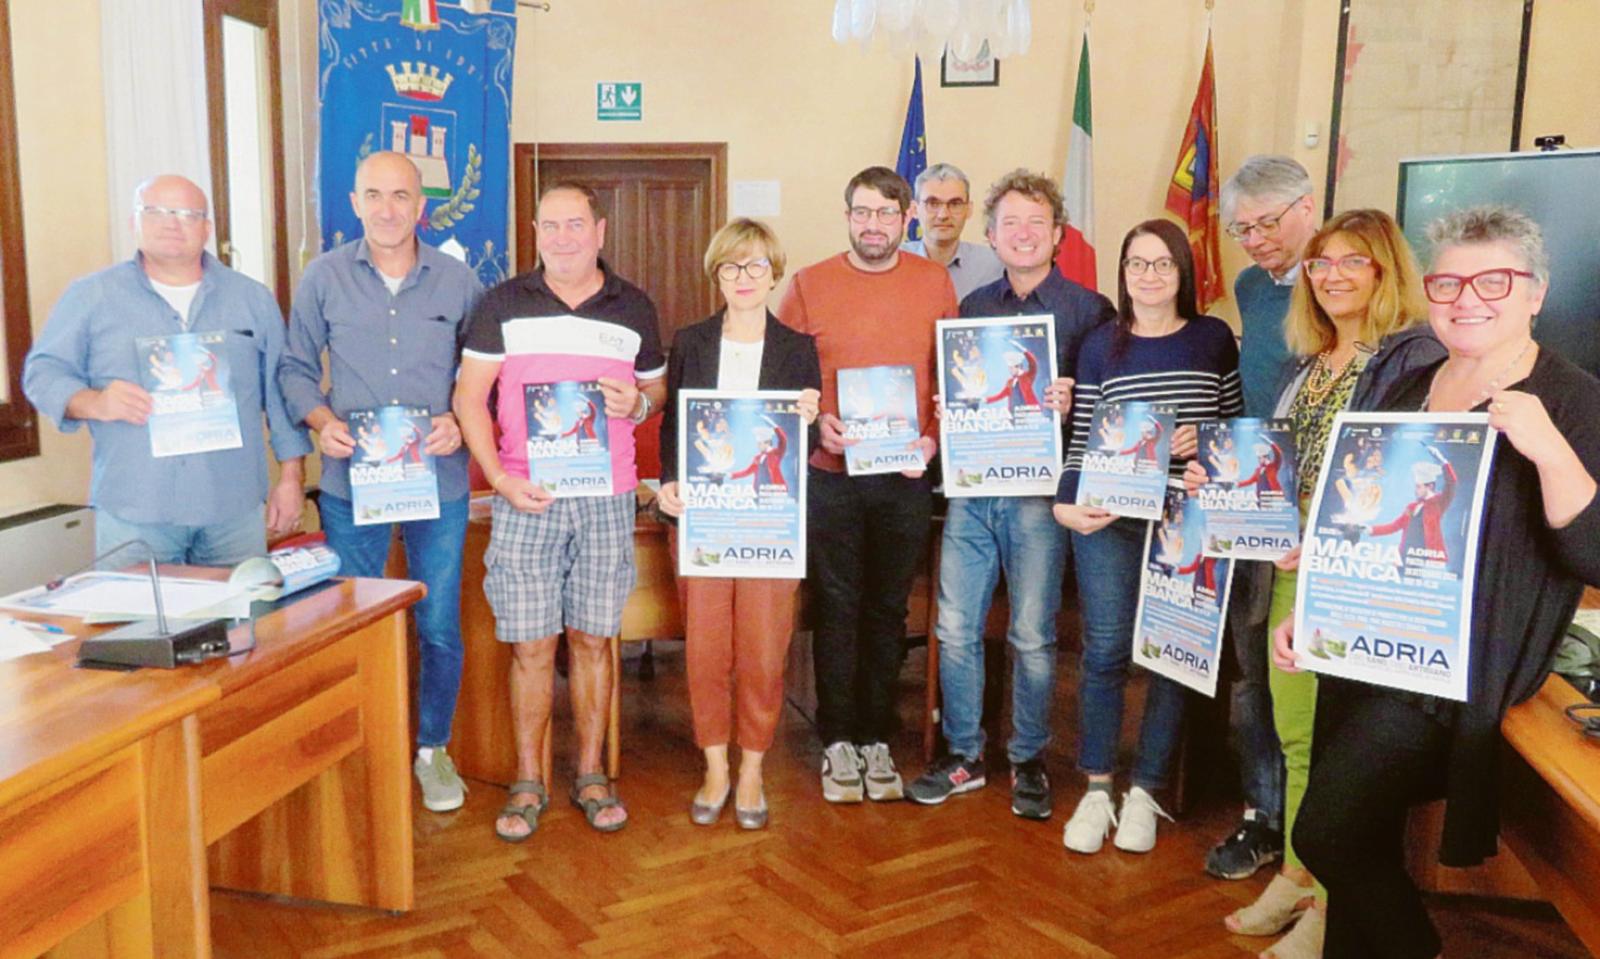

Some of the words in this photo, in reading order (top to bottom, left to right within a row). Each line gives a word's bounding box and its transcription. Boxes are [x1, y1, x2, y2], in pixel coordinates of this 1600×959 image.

[945, 406, 1013, 422] MAGIA
[945, 419, 1015, 433] BIANCA
[874, 454, 920, 464] ADRIA
[985, 466, 1053, 479] ADRIA
[559, 476, 607, 487] ADRIA
[686, 483, 758, 498] MAGIA
[1199, 489, 1258, 502] MAGIA
[384, 499, 433, 511] ADRIA
[685, 497, 758, 510] BIANCA
[1105, 495, 1157, 509] ADRIA
[1200, 500, 1260, 511] BIANCA
[1234, 535, 1292, 549] ADRIA
[723, 547, 794, 560] ADRIA
[1310, 536, 1404, 567] MAGIA
[1406, 546, 1446, 559] ADRIA
[1308, 555, 1401, 584] BIANCA
[1146, 569, 1196, 597] MAGIA
[1144, 583, 1194, 611] BIANCA
[1162, 644, 1210, 674] ADRIA
[1351, 635, 1450, 670] ADRIA
